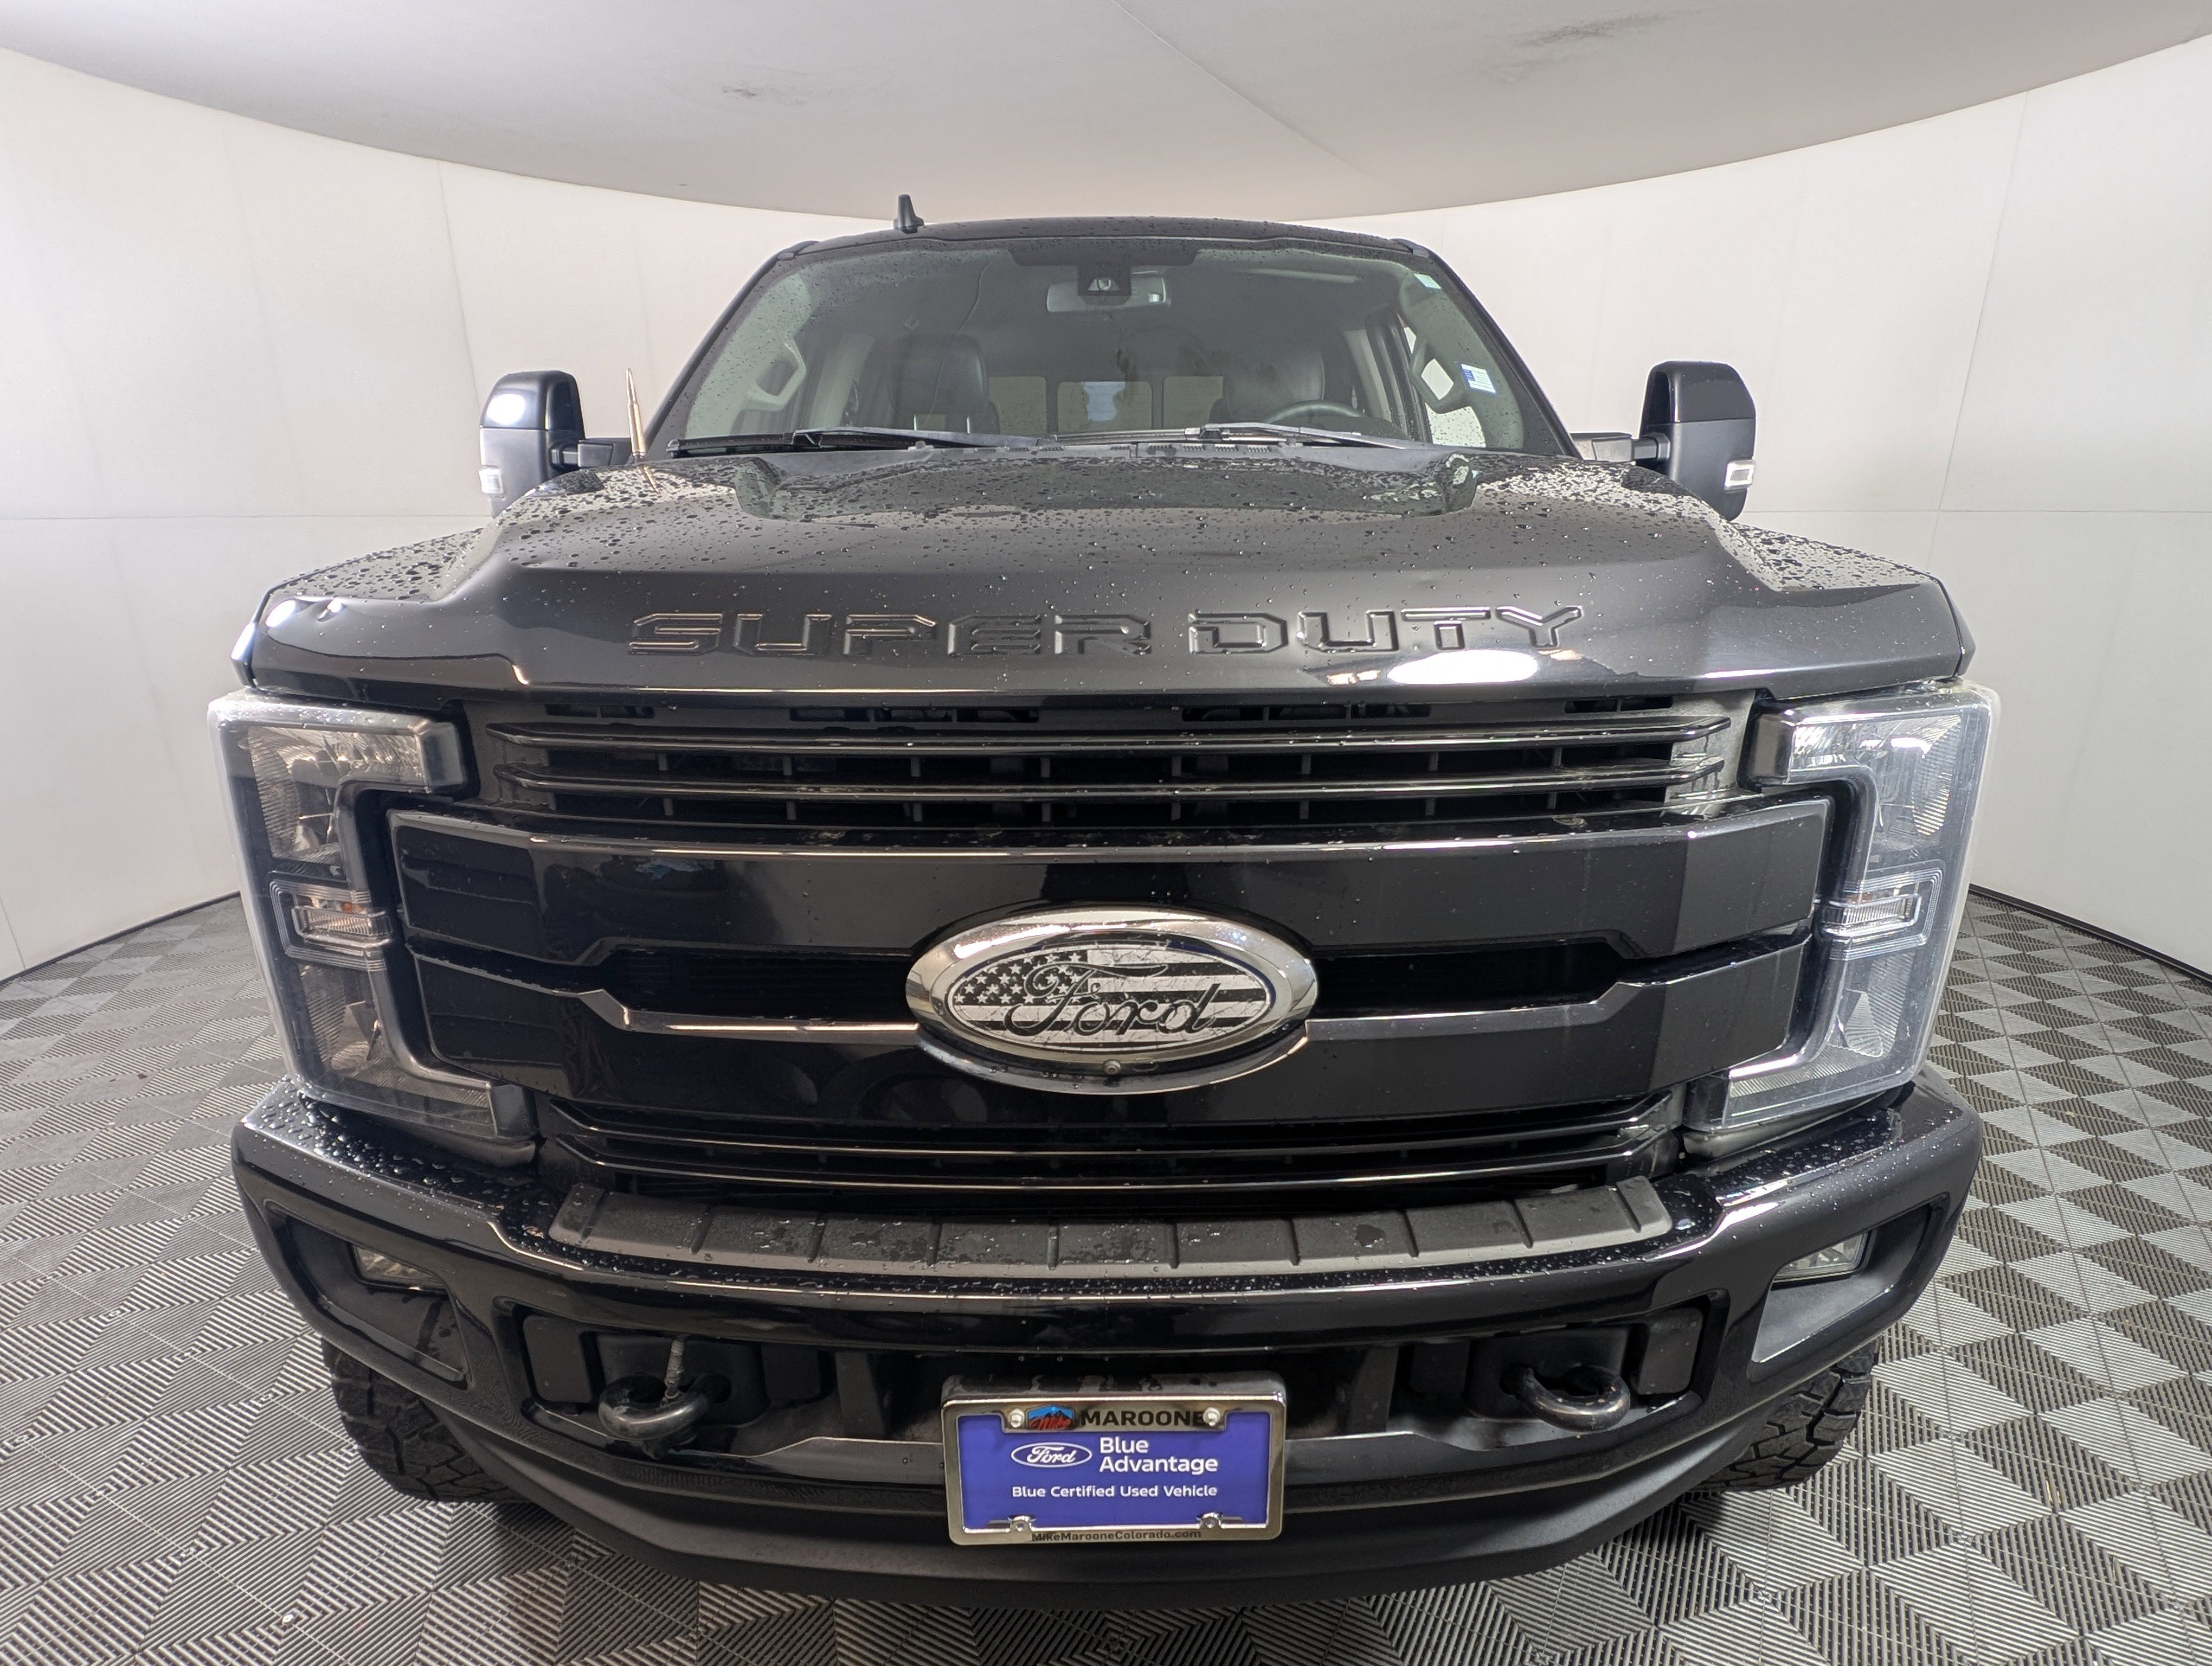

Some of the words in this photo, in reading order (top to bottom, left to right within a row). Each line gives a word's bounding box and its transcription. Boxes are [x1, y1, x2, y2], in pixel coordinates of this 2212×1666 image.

[628, 612, 1152, 655] SUPER
[1188, 606, 1583, 655] DUTY
[1004, 962, 1221, 1037] Ford
[1099, 1436, 1149, 1453] Blue
[1026, 1445, 1078, 1464] Ford
[1099, 1456, 1218, 1475] Advantage
[1012, 1486, 1046, 1497] Blue
[1051, 1485, 1115, 1497] Certified
[1120, 1485, 1158, 1497] Used
[1163, 1485, 1218, 1497] Vehicle
